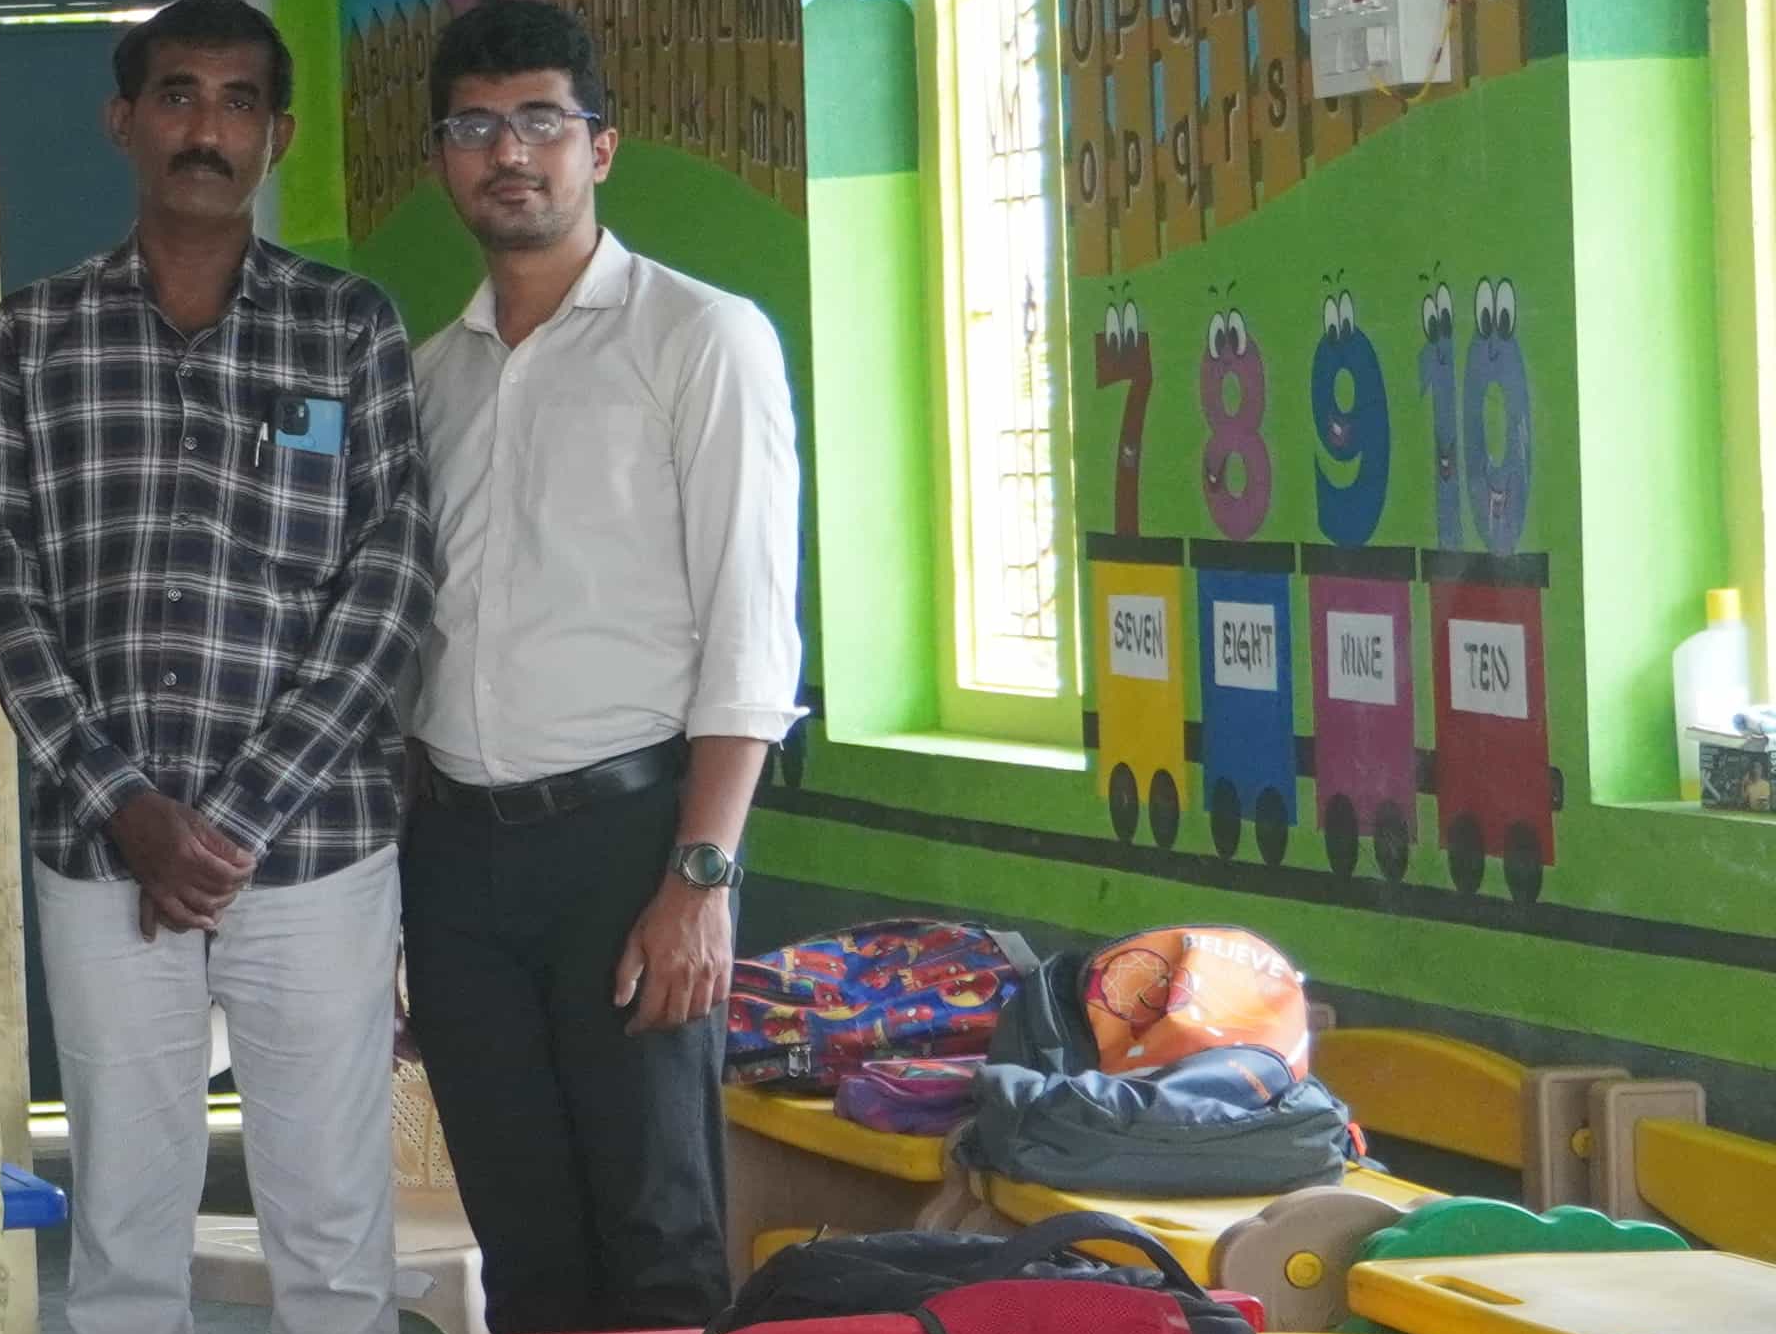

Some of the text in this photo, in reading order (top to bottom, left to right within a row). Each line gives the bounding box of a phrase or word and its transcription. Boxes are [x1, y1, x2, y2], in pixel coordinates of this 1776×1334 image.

[1311, 324, 1390, 547] 9
[1114, 610, 1510, 692] SEVEN EIGHT NINE TEN
[1184, 934, 1289, 979] BELIEVE
